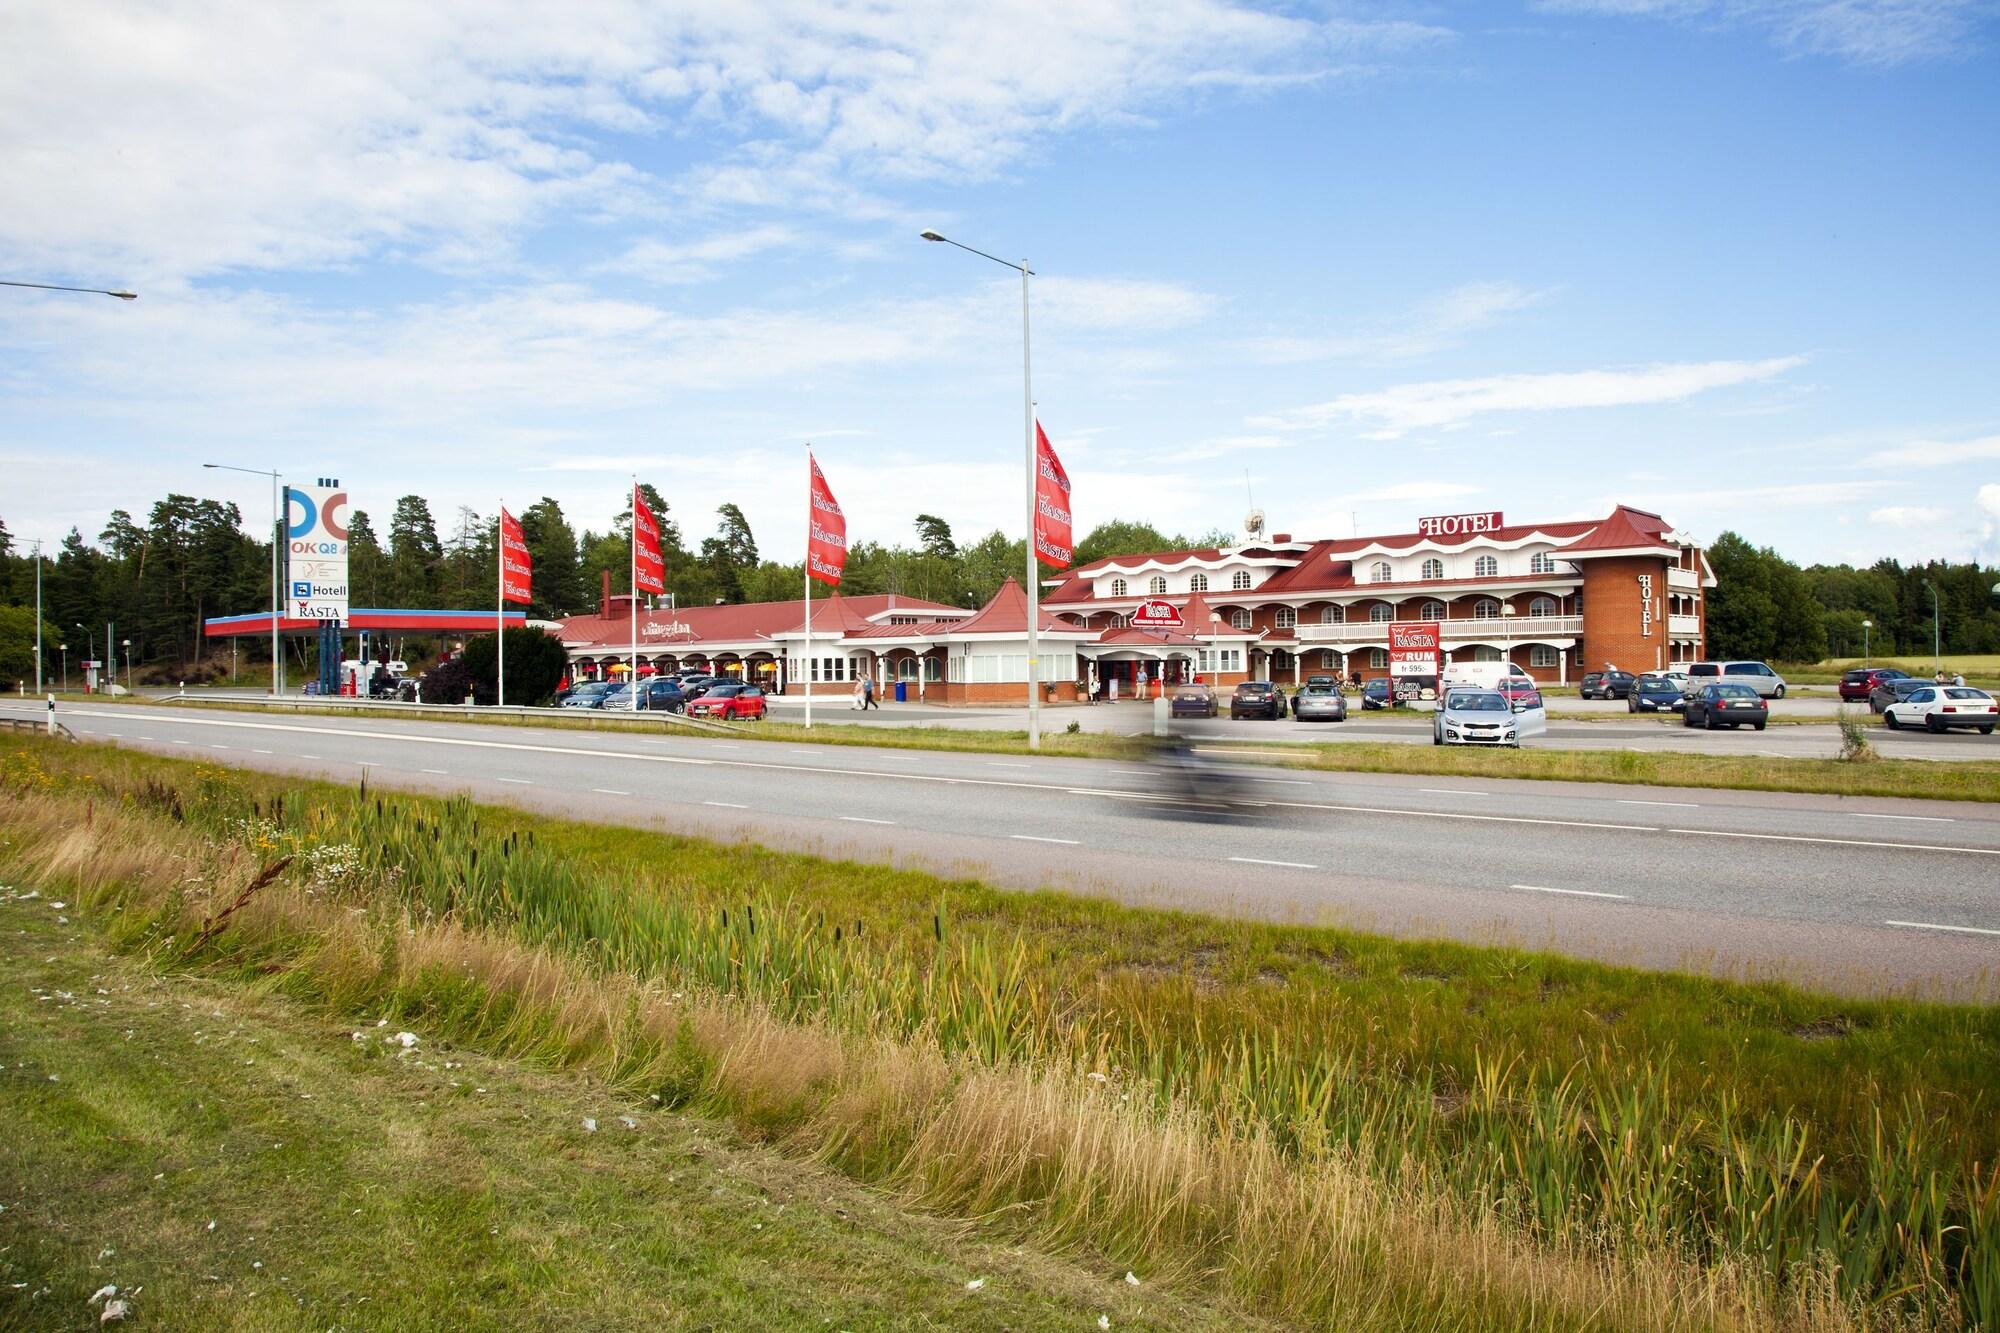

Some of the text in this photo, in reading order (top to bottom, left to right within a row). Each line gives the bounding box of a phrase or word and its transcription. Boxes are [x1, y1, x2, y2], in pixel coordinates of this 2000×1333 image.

[1419, 513, 1502, 536] HOTEL
[1037, 539, 1072, 562] RASTA
[313, 586, 346, 596] Hotell
[1638, 575, 1652, 635] HOTEL
[299, 606, 340, 617] RASTA
[1394, 634, 1435, 647] RASTA
[1406, 652, 1435, 661] RUM
[1396, 691, 1418, 699] Grill
